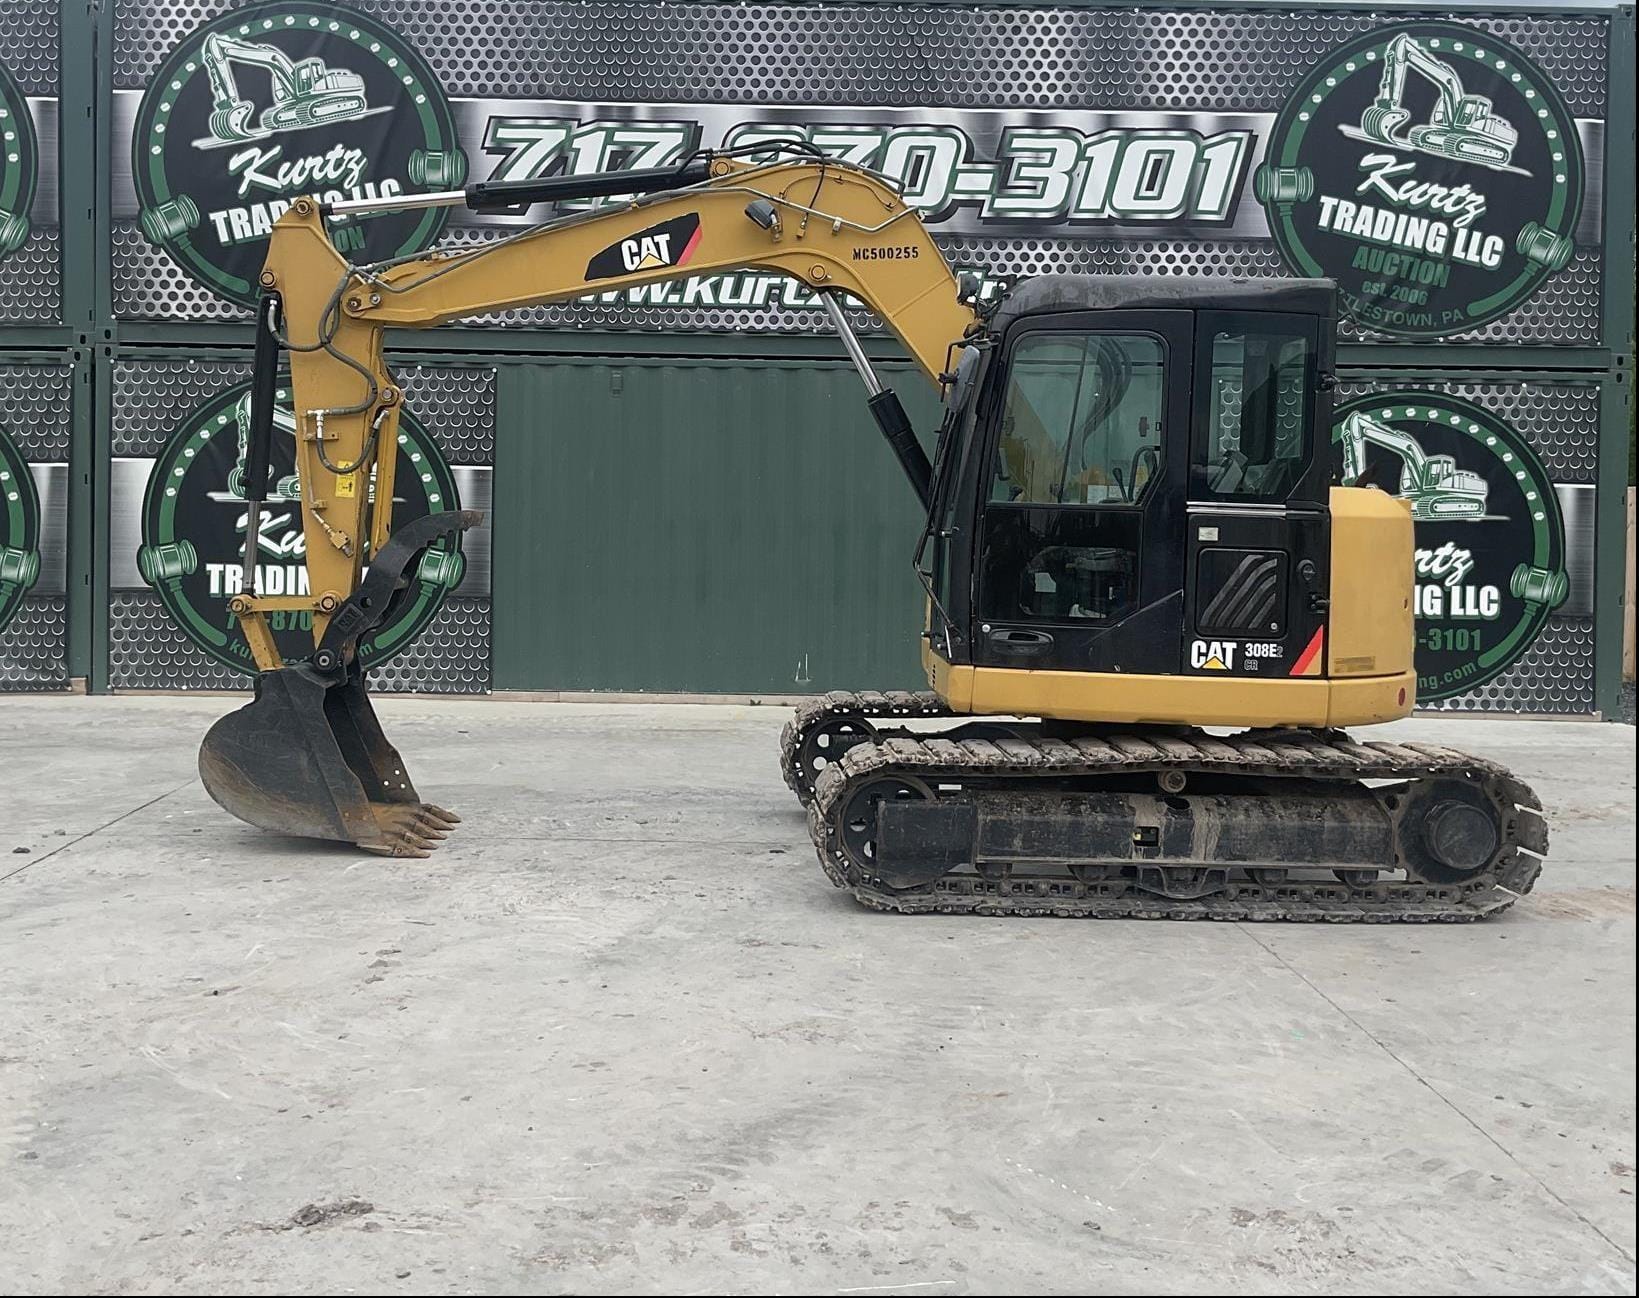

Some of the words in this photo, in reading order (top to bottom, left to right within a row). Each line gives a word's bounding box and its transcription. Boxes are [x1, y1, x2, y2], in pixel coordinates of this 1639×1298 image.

[228, 143, 368, 196] Kurtz
[488, 120, 1250, 222] 7170-3101
[1356, 152, 1487, 228] Kurtz
[209, 189, 345, 244] TRADG
[1318, 195, 1449, 256] TRADING
[1452, 227, 1505, 268] LLC
[620, 233, 671, 272] CAT
[853, 246, 919, 260] MC500255
[1352, 246, 1450, 288] AUCTION
[1362, 280, 1387, 299] est.
[1390, 284, 1429, 306] 2006
[1442, 308, 1464, 323] PA
[1414, 541, 1474, 587] rtz
[1451, 584, 1499, 617] LLC
[1190, 640, 1237, 670] CAT
[1244, 659, 1258, 670] CR
